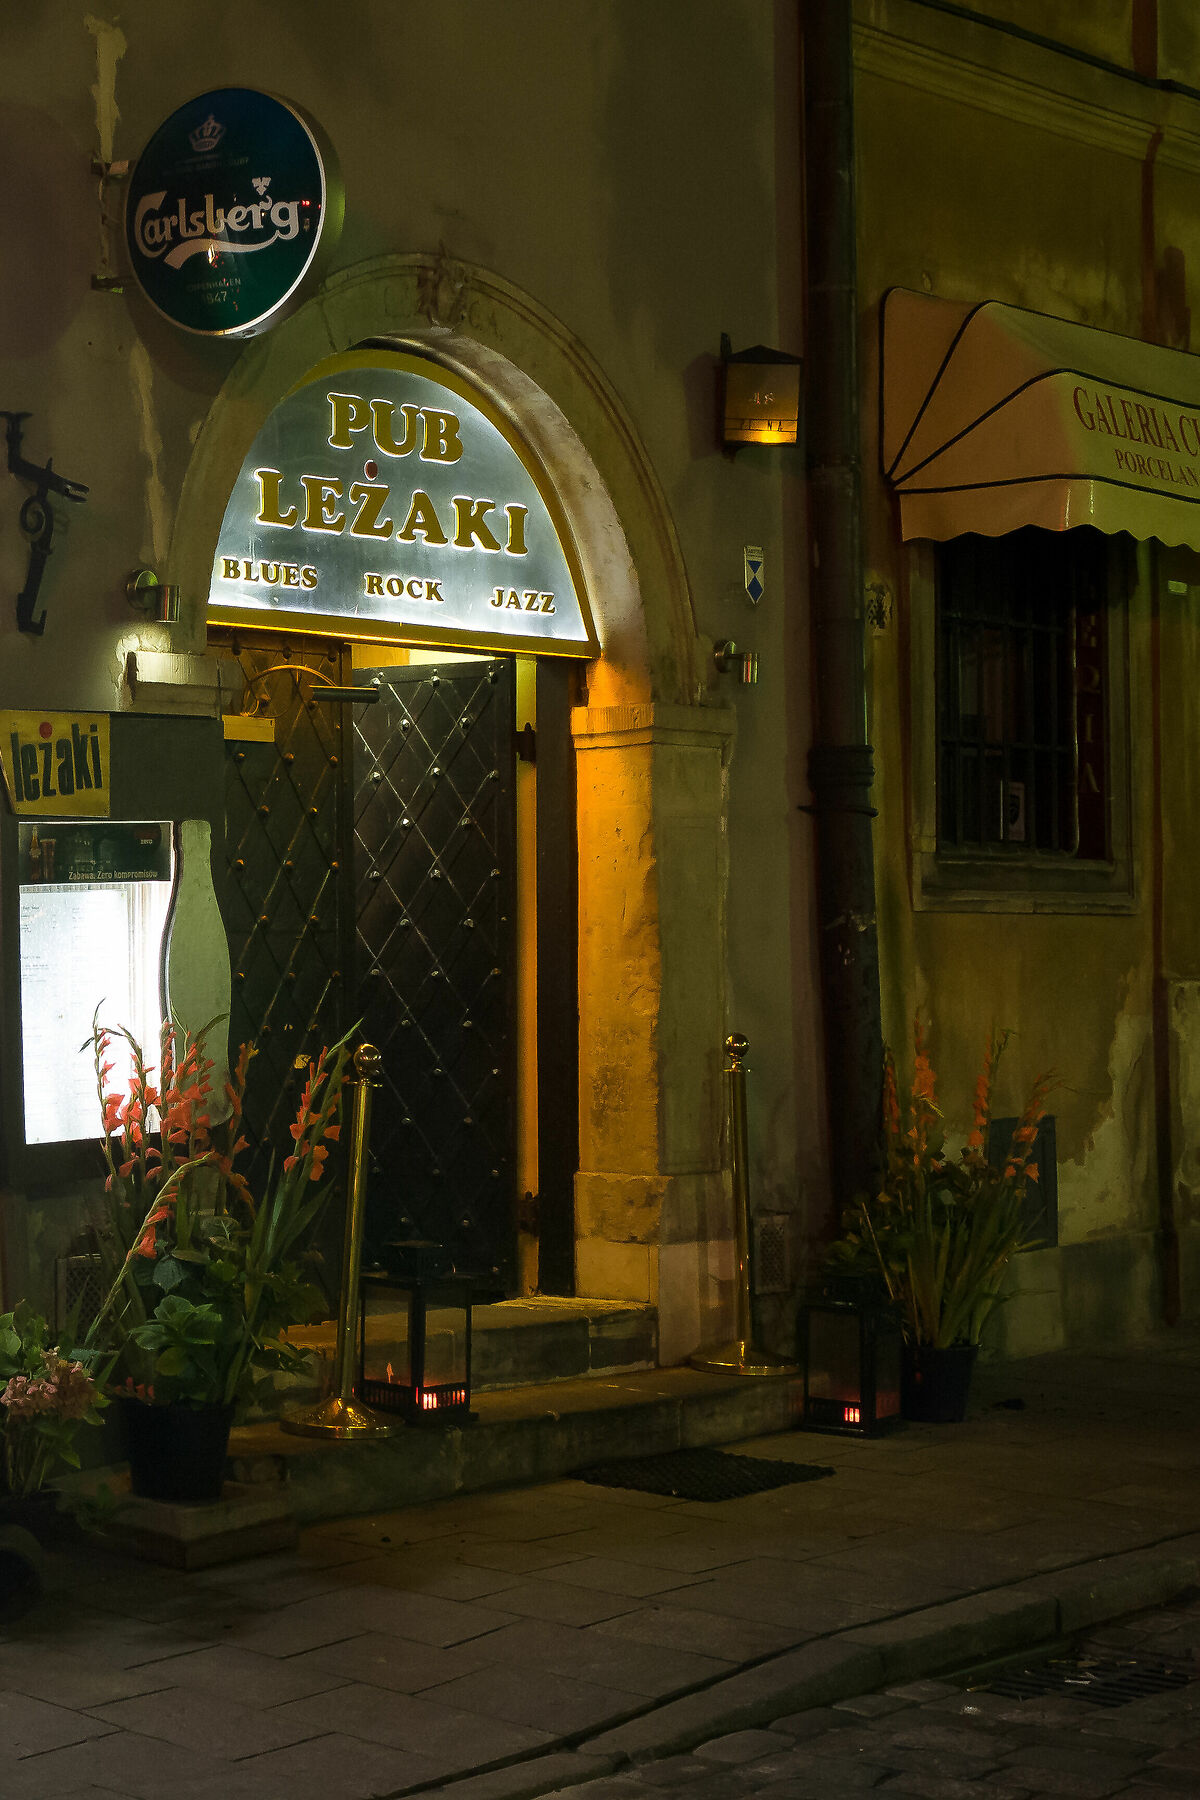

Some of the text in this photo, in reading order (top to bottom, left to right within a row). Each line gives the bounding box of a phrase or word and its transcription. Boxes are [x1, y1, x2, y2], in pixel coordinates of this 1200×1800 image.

[135, 190, 300, 260] Carlsberg
[327, 392, 465, 466] PUB
[1073, 386, 1181, 453] GALERIA
[253, 460, 529, 557] LEŻAKI
[220, 558, 556, 615] BLUES ROCK JAZZ
[10, 721, 103, 802] leżaki
[97, 870, 111, 880] Zero
